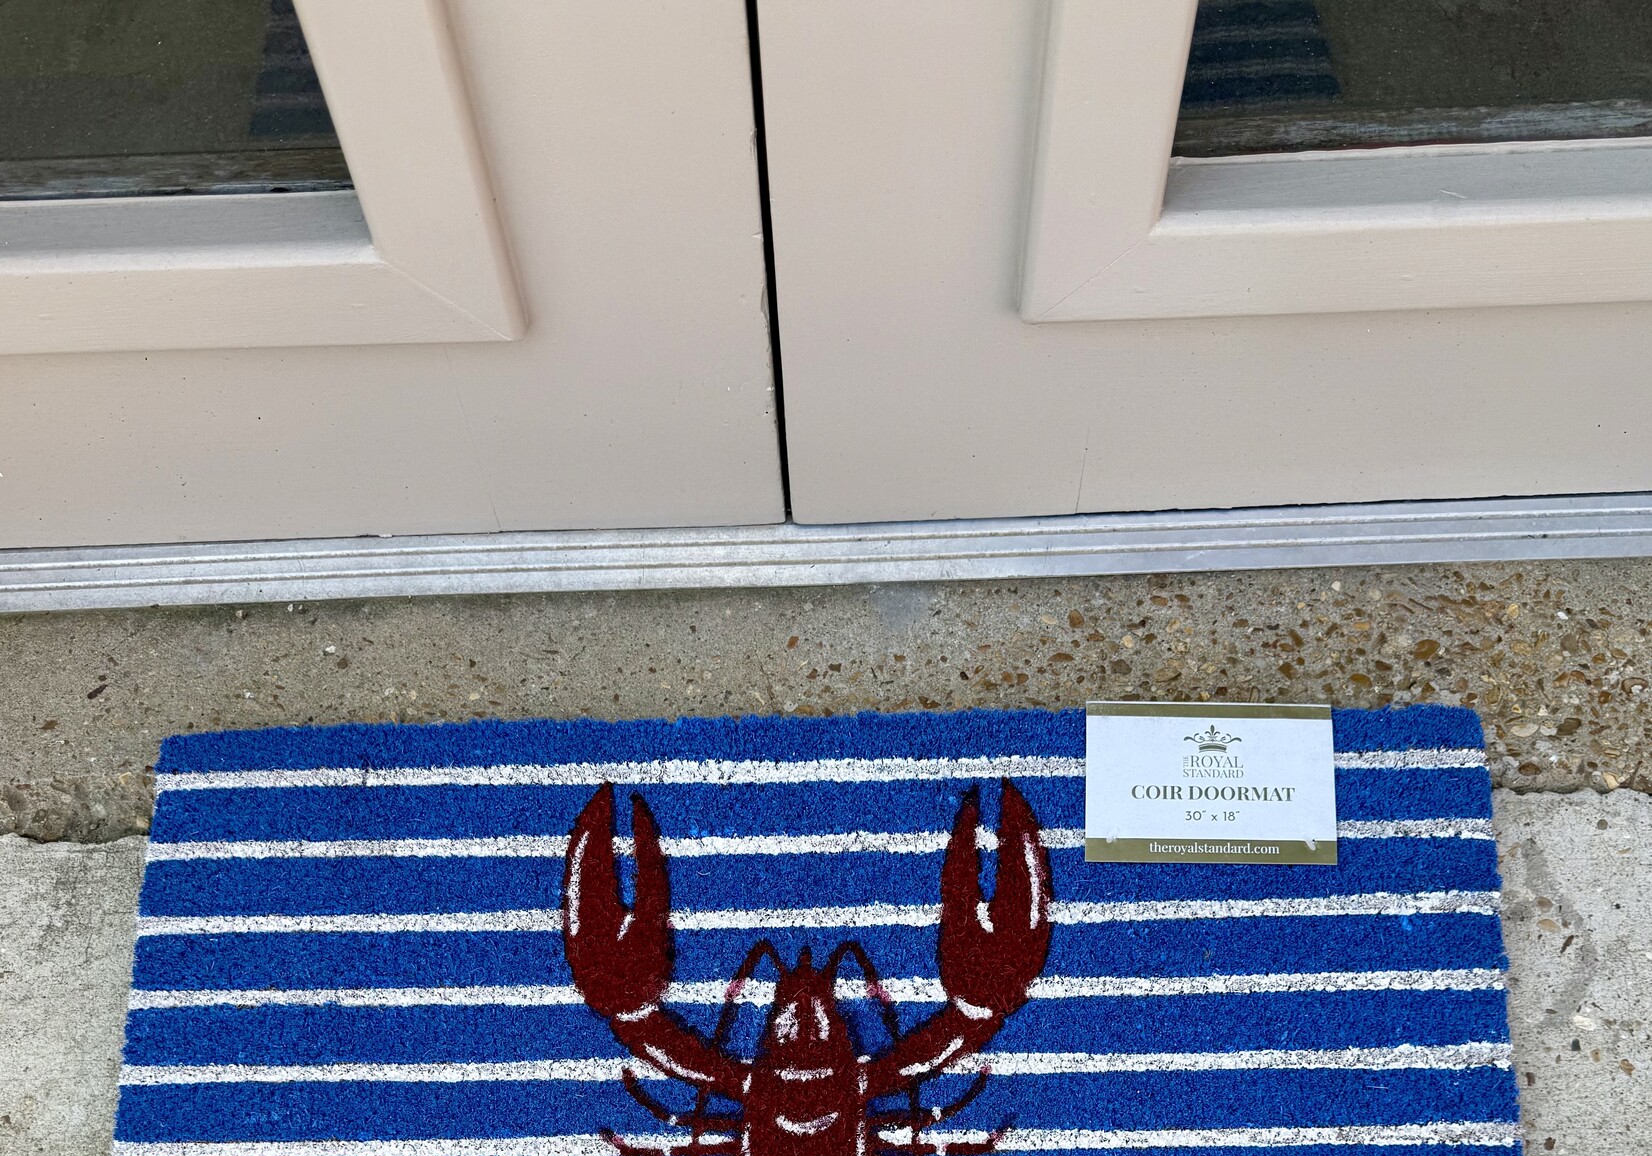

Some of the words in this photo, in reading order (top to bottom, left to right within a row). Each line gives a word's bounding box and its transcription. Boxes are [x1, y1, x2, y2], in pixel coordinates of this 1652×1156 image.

[1190, 755, 1244, 768] ROYAL
[1182, 769, 1244, 779] STANDARD
[1131, 784, 1183, 800] COIR
[1188, 785, 1296, 802] DOORMAT
[1211, 814, 1218, 822] x
[1149, 842, 1280, 856] theroyalstandard.com
